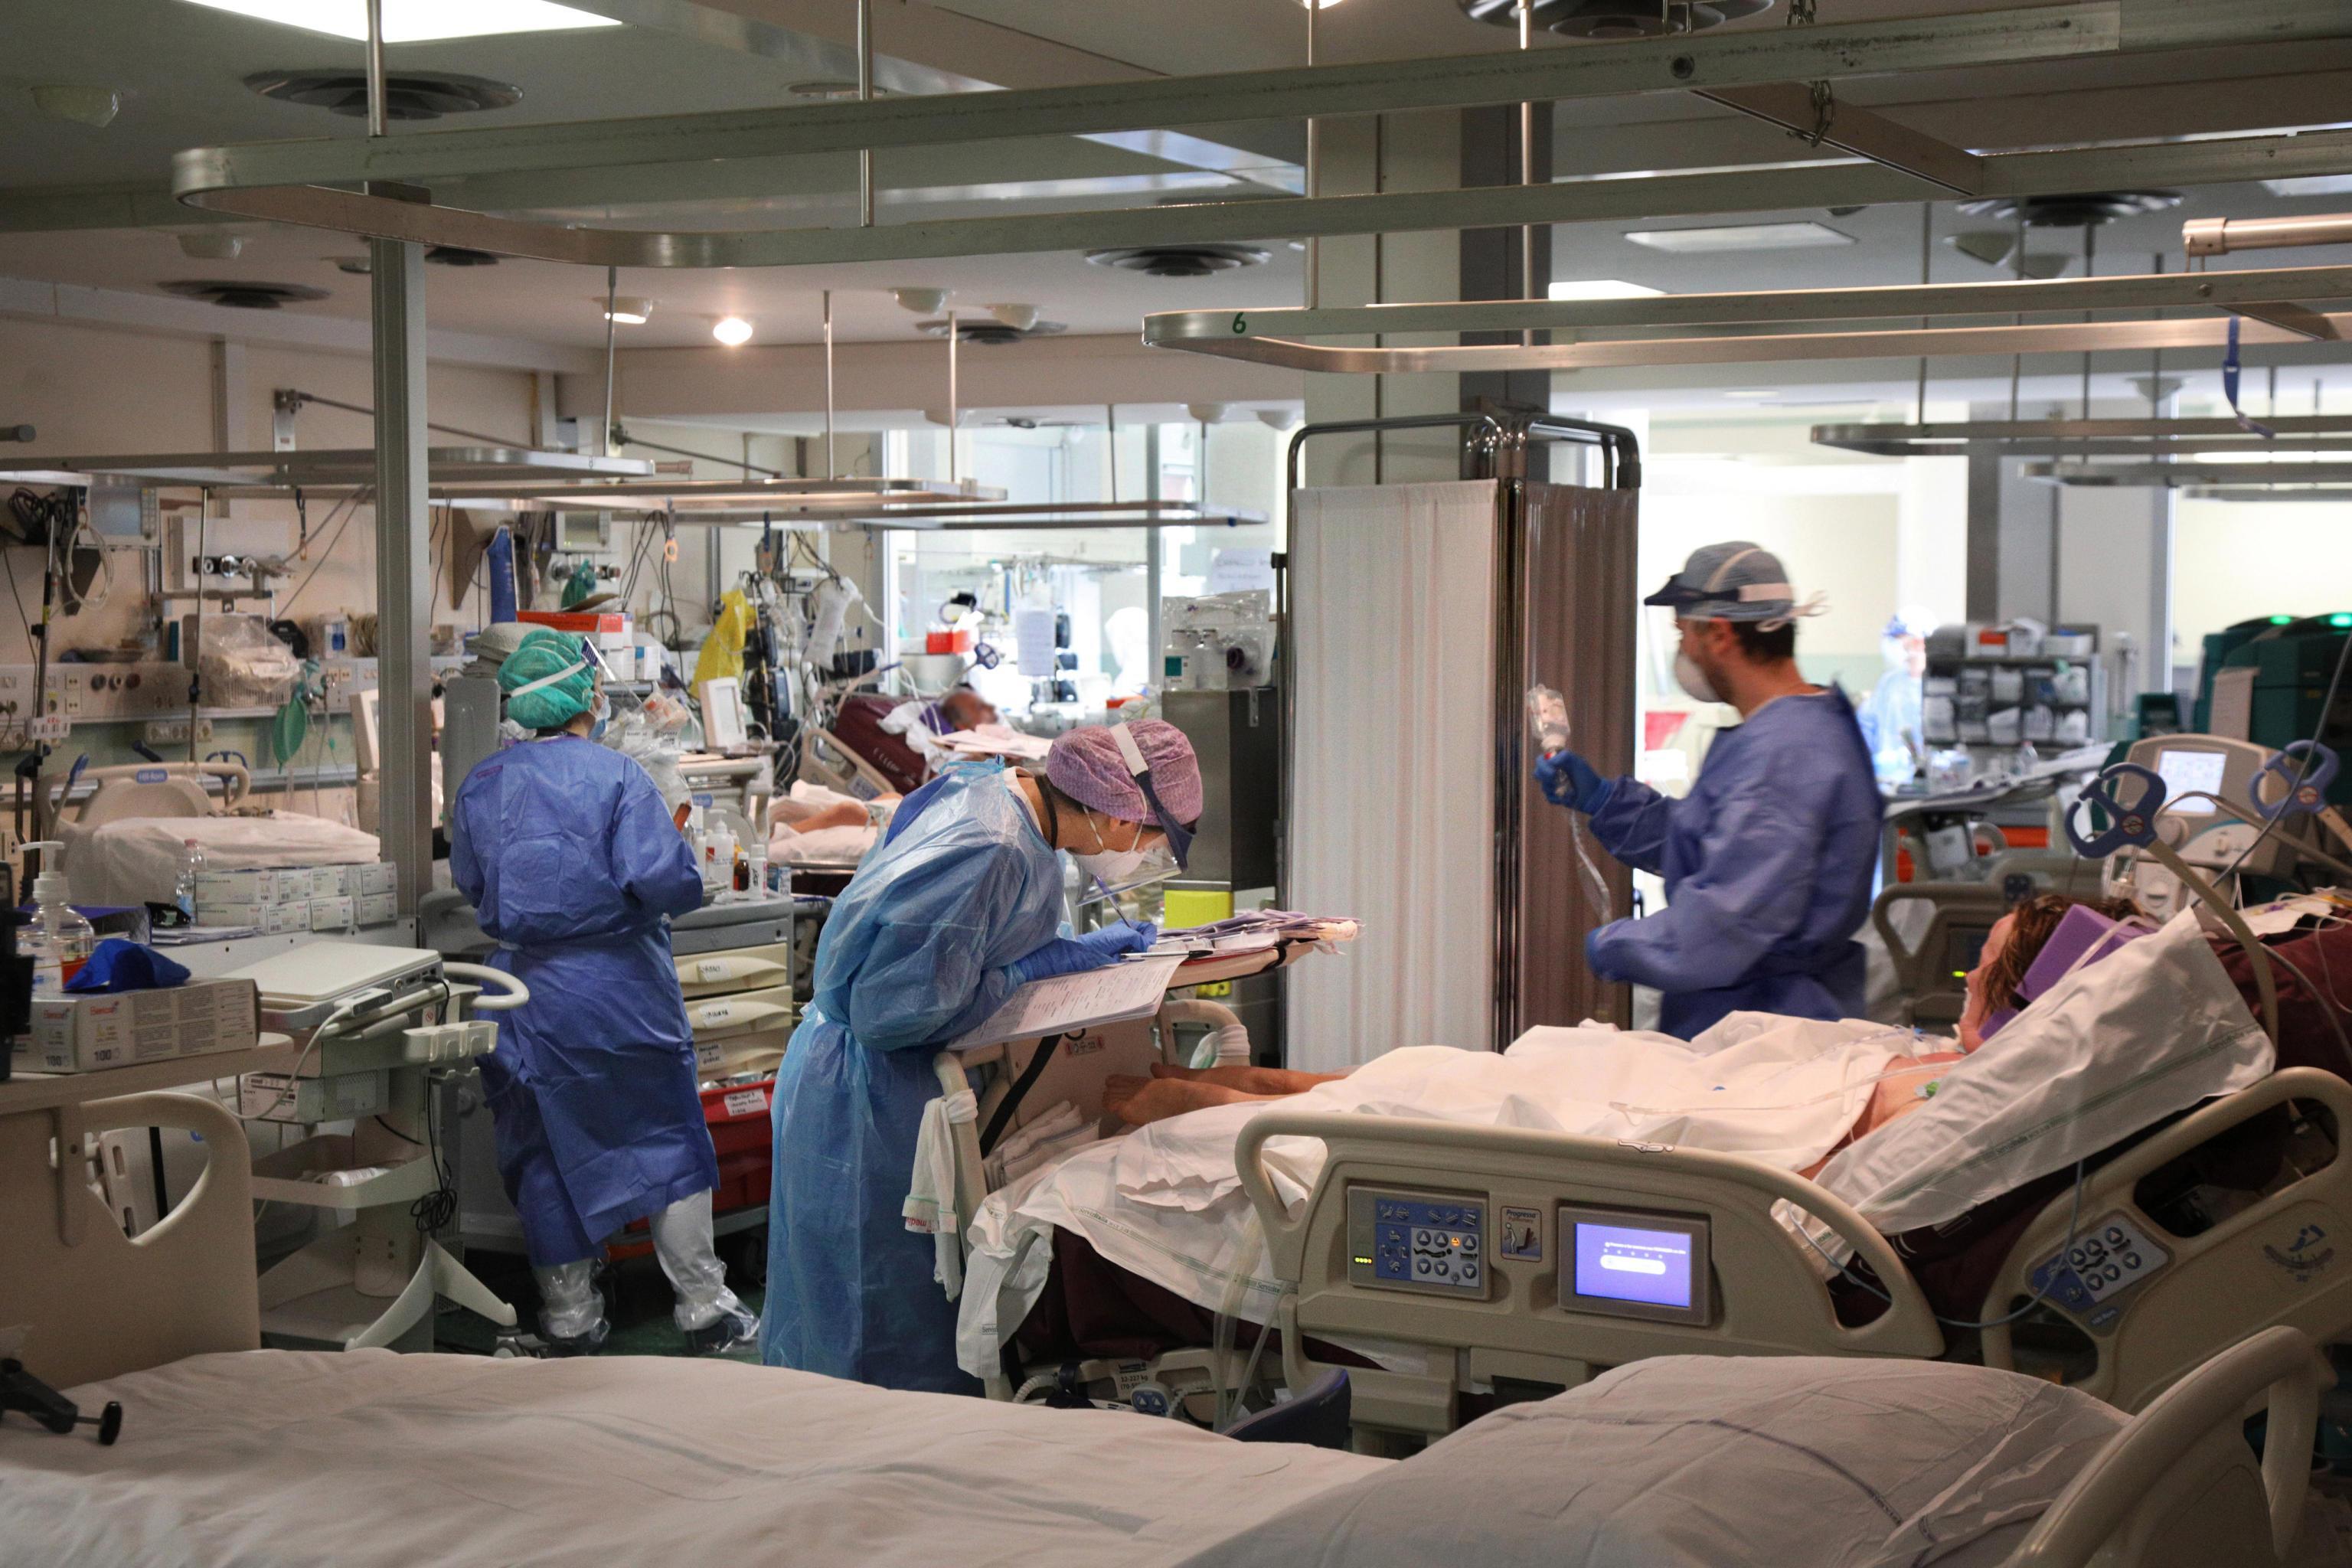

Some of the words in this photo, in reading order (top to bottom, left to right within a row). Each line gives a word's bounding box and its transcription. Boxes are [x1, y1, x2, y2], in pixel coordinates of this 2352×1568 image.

[1233, 312, 1246, 335] 6
[45, 1055, 62, 1067] 100
[93, 1049, 113, 1061] 100
[1506, 1209, 1536, 1219] Progressa
